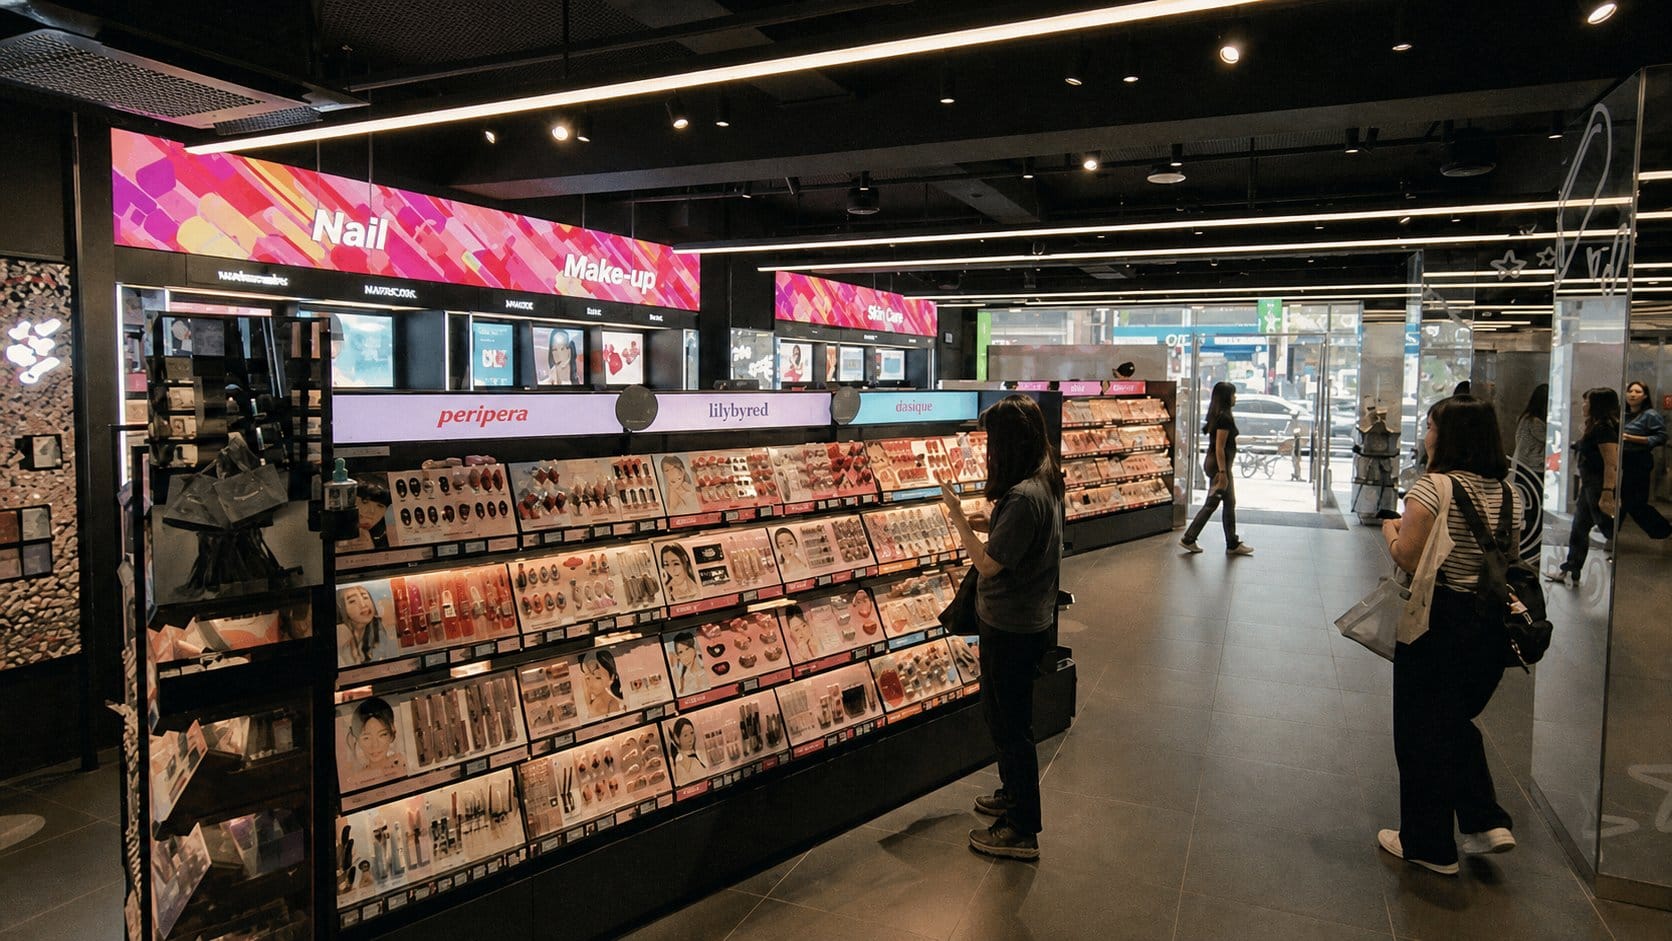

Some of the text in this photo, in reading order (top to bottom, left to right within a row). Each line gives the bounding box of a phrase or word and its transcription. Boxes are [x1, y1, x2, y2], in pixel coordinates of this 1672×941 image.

[312, 208, 389, 250] Nail
[564, 253, 657, 295] Make-up
[867, 304, 904, 324] Skin Care
[437, 405, 529, 428] peripera
[709, 402, 769, 422] lilybyred
[895, 399, 933, 415] dasique
